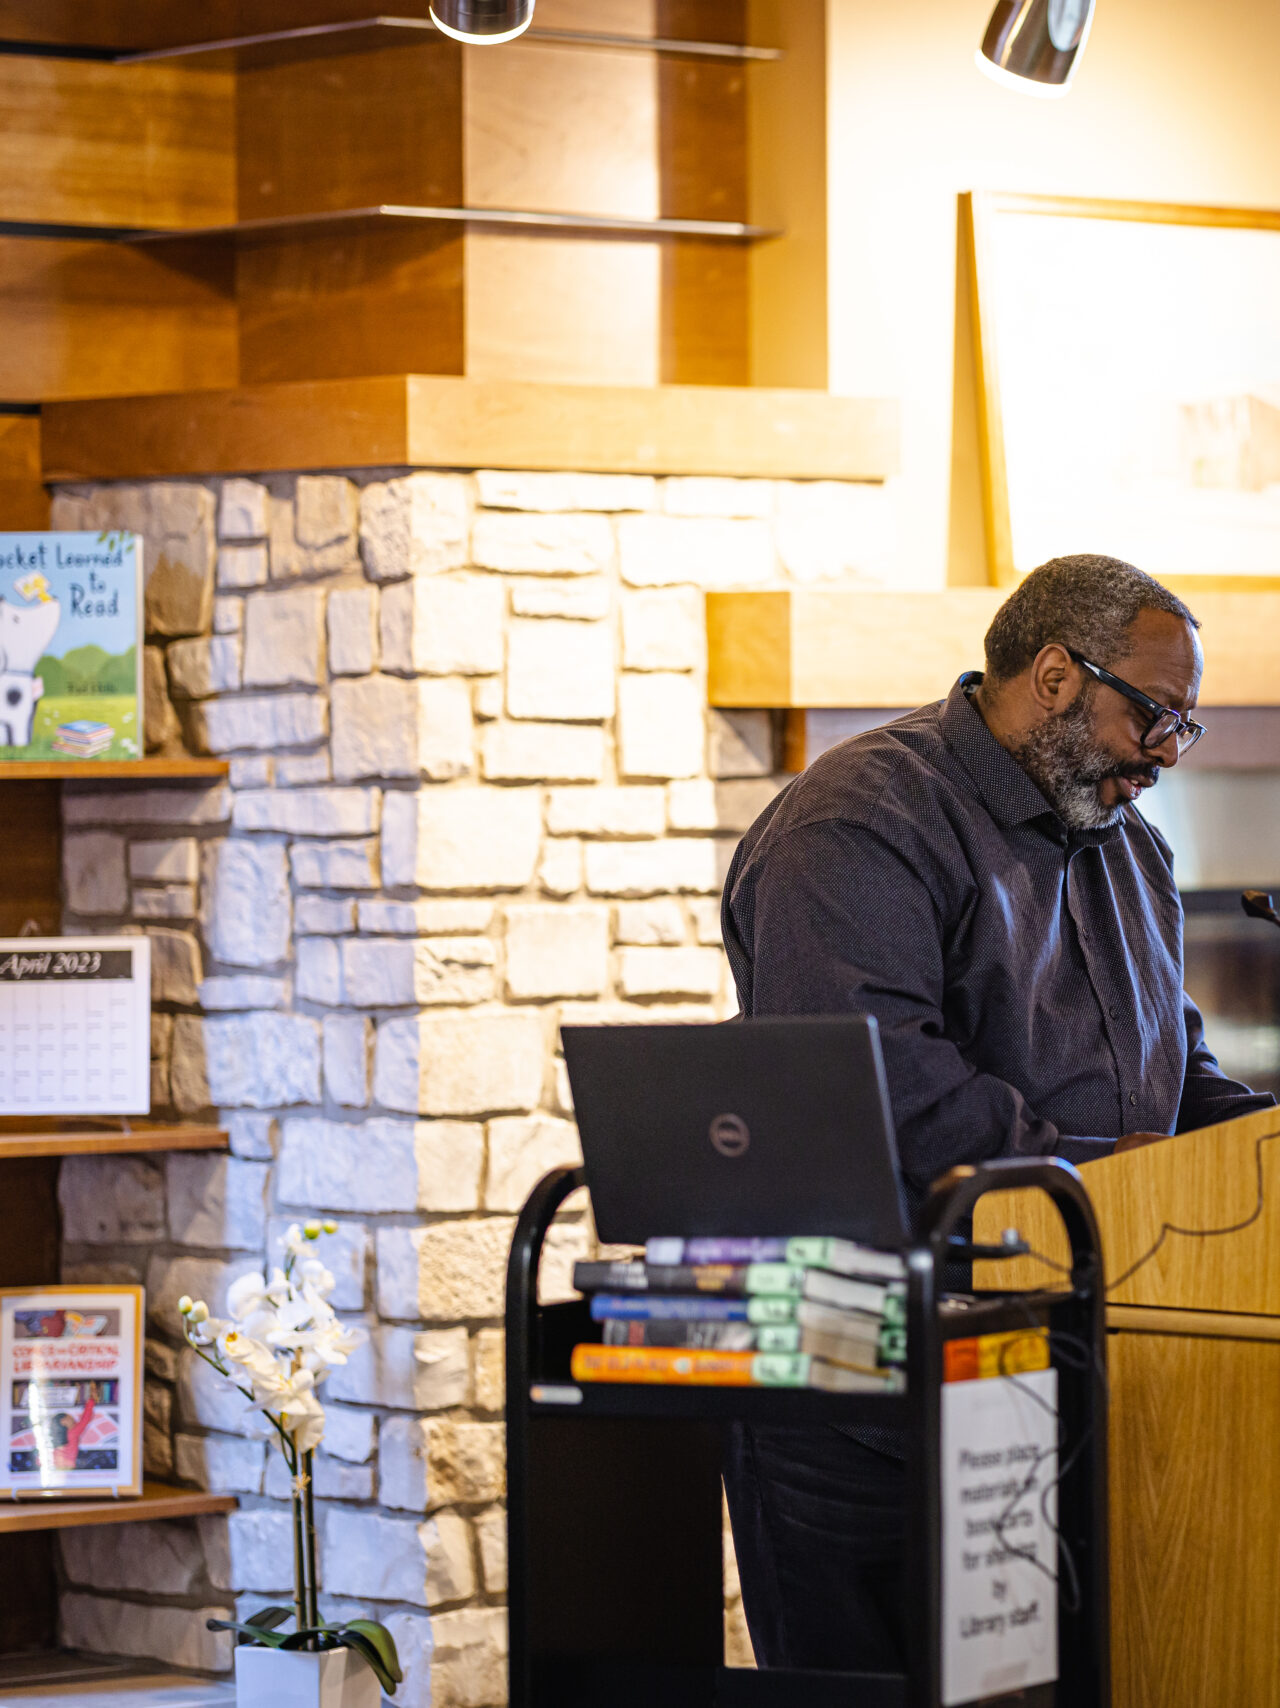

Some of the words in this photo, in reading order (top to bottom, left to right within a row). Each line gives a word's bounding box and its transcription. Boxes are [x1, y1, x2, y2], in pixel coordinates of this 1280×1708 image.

[56, 542, 123, 569] Learned
[89, 568, 106, 593] to
[70, 582, 118, 618] Read
[0, 952, 51, 979] April
[52, 951, 102, 974] 2023
[959, 1447, 1002, 1470] Please
[960, 1614, 1006, 1640] Library
